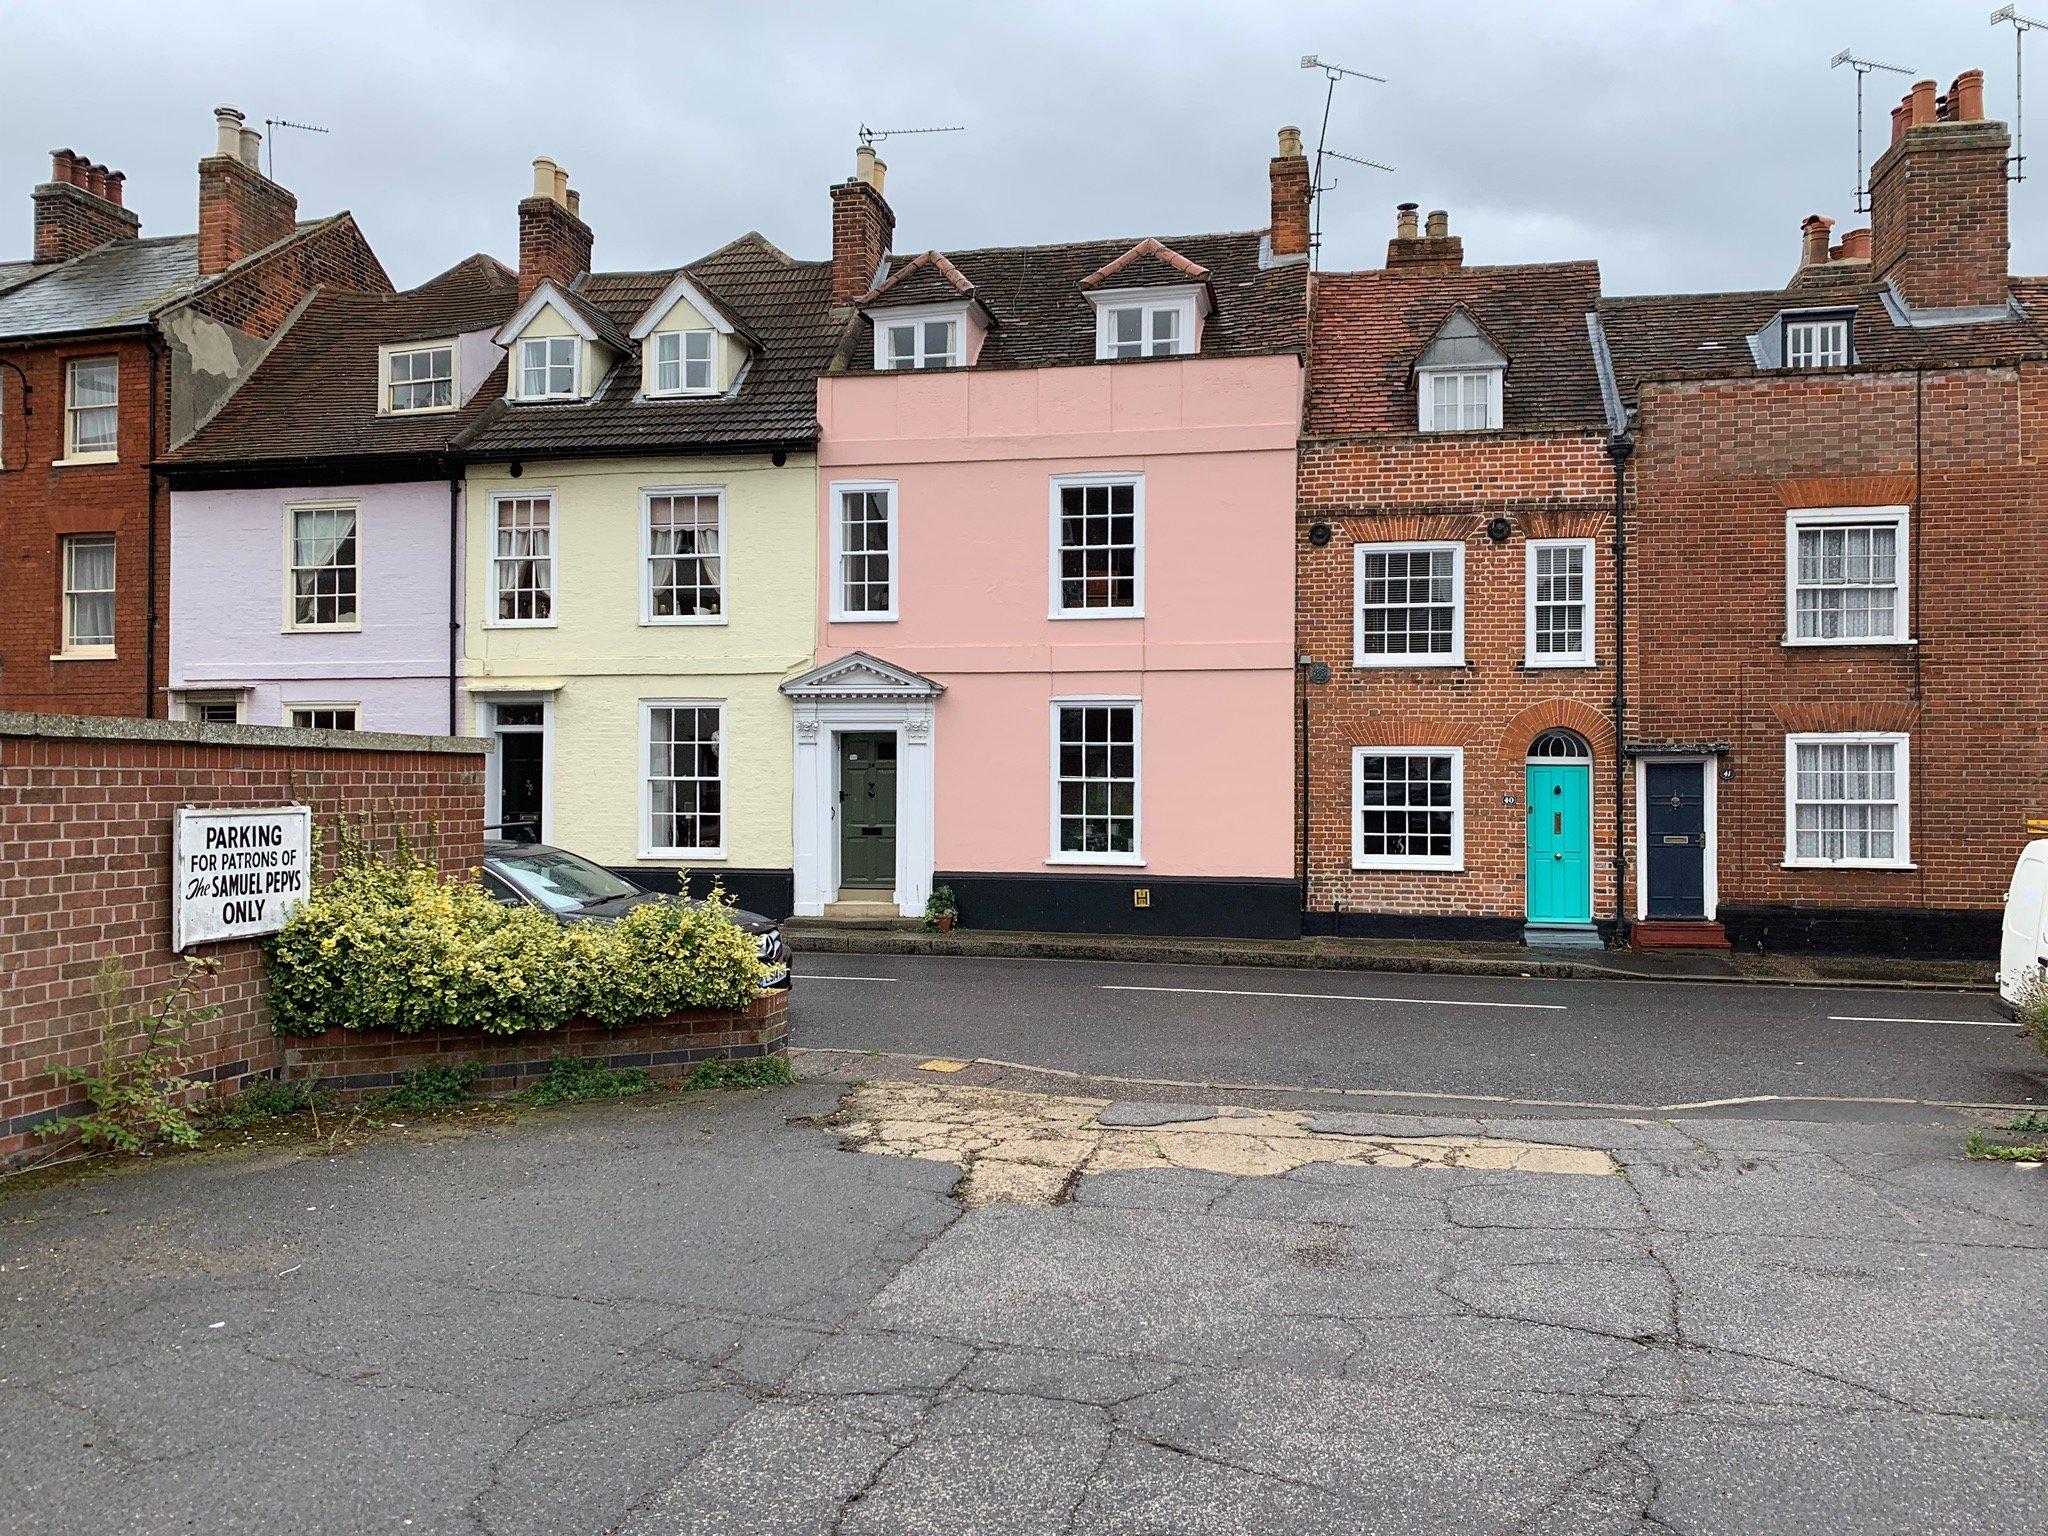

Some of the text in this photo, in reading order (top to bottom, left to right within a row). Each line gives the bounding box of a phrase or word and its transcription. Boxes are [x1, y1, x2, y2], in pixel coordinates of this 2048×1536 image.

[206, 825, 282, 850] PARKING
[191, 849, 297, 872] FOR PATRONS OF
[185, 870, 301, 900] The SAMUEL PEPYS
[1136, 891, 1148, 905] H
[222, 899, 266, 924] ONLY
